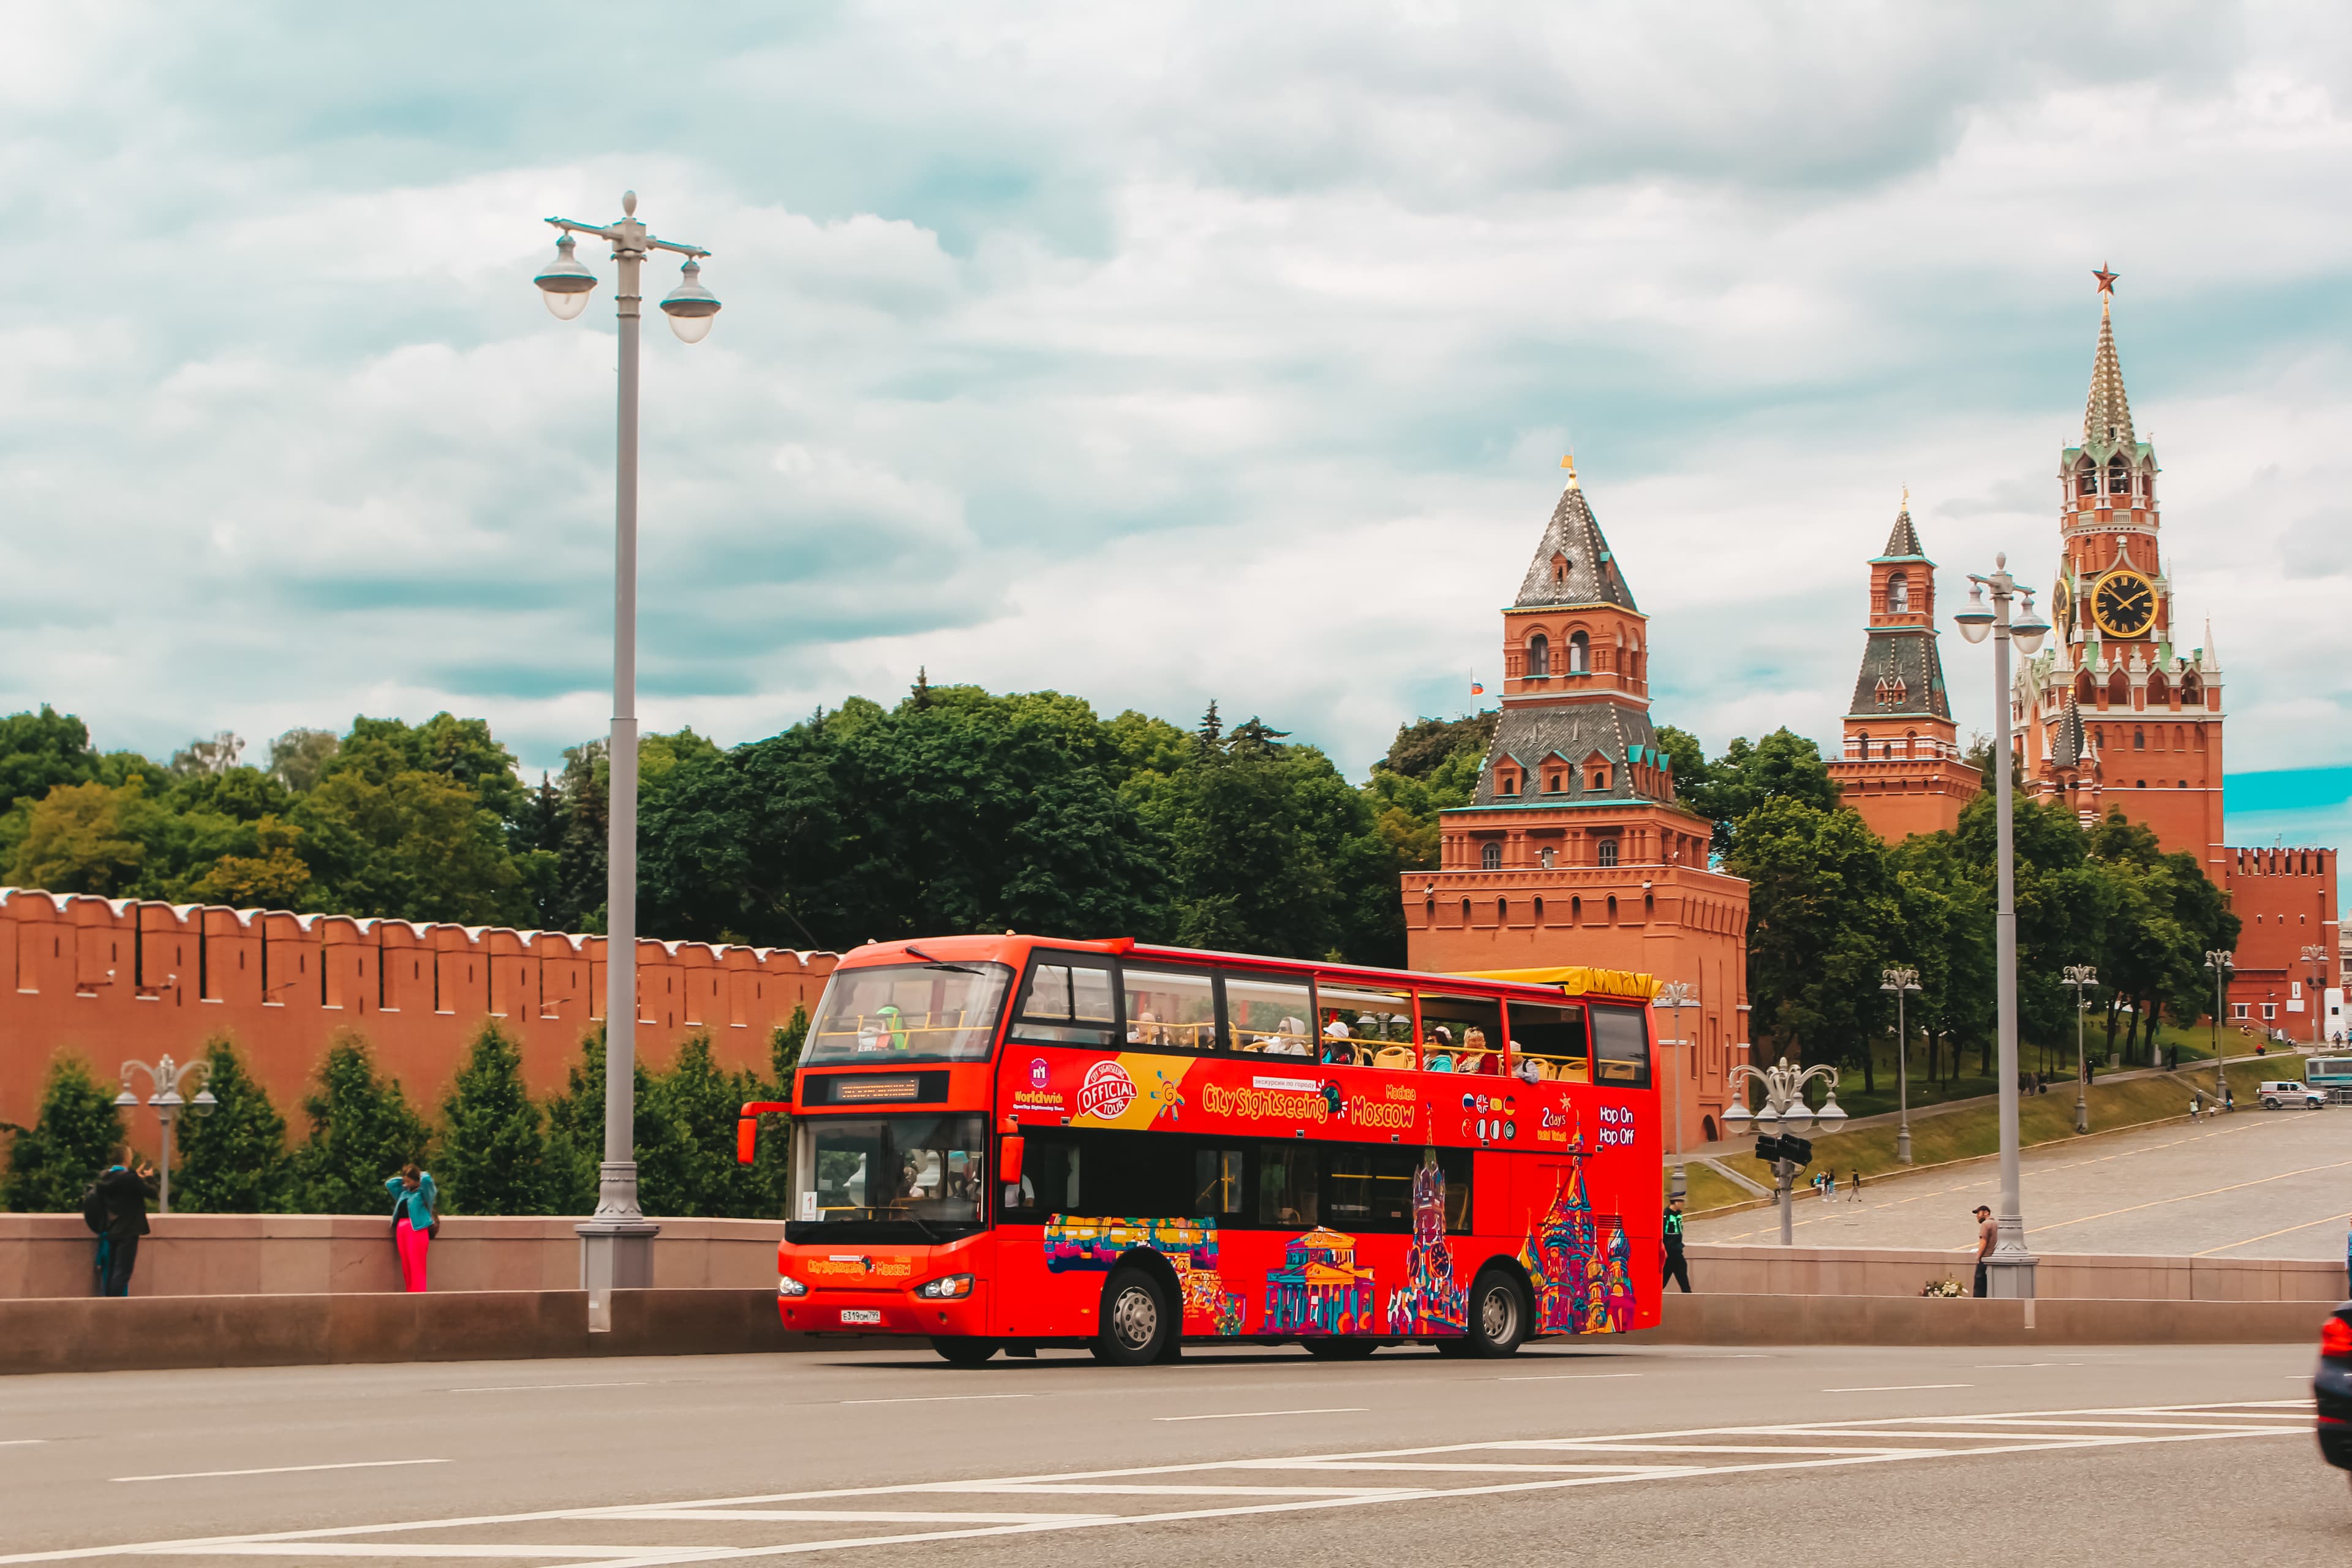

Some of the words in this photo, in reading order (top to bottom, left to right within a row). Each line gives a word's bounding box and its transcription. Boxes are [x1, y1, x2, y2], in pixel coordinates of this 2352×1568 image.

[1254, 1079, 1285, 1088] экскурсии
[1014, 1090, 1063, 1104] Worldwide
[1082, 1082, 1136, 1109] OFFICIAL
[1385, 1084, 1416, 1101] Москва
[1103, 1099, 1126, 1115] TOUR
[1203, 1083, 1235, 1117] City
[1236, 1087, 1329, 1125] Sightseeing
[1600, 1106, 1618, 1124] Hop
[1621, 1106, 1634, 1123] On
[1599, 1128, 1618, 1145] Hop
[1620, 1128, 1634, 1144] Off
[807, 1196, 812, 1210] 1
